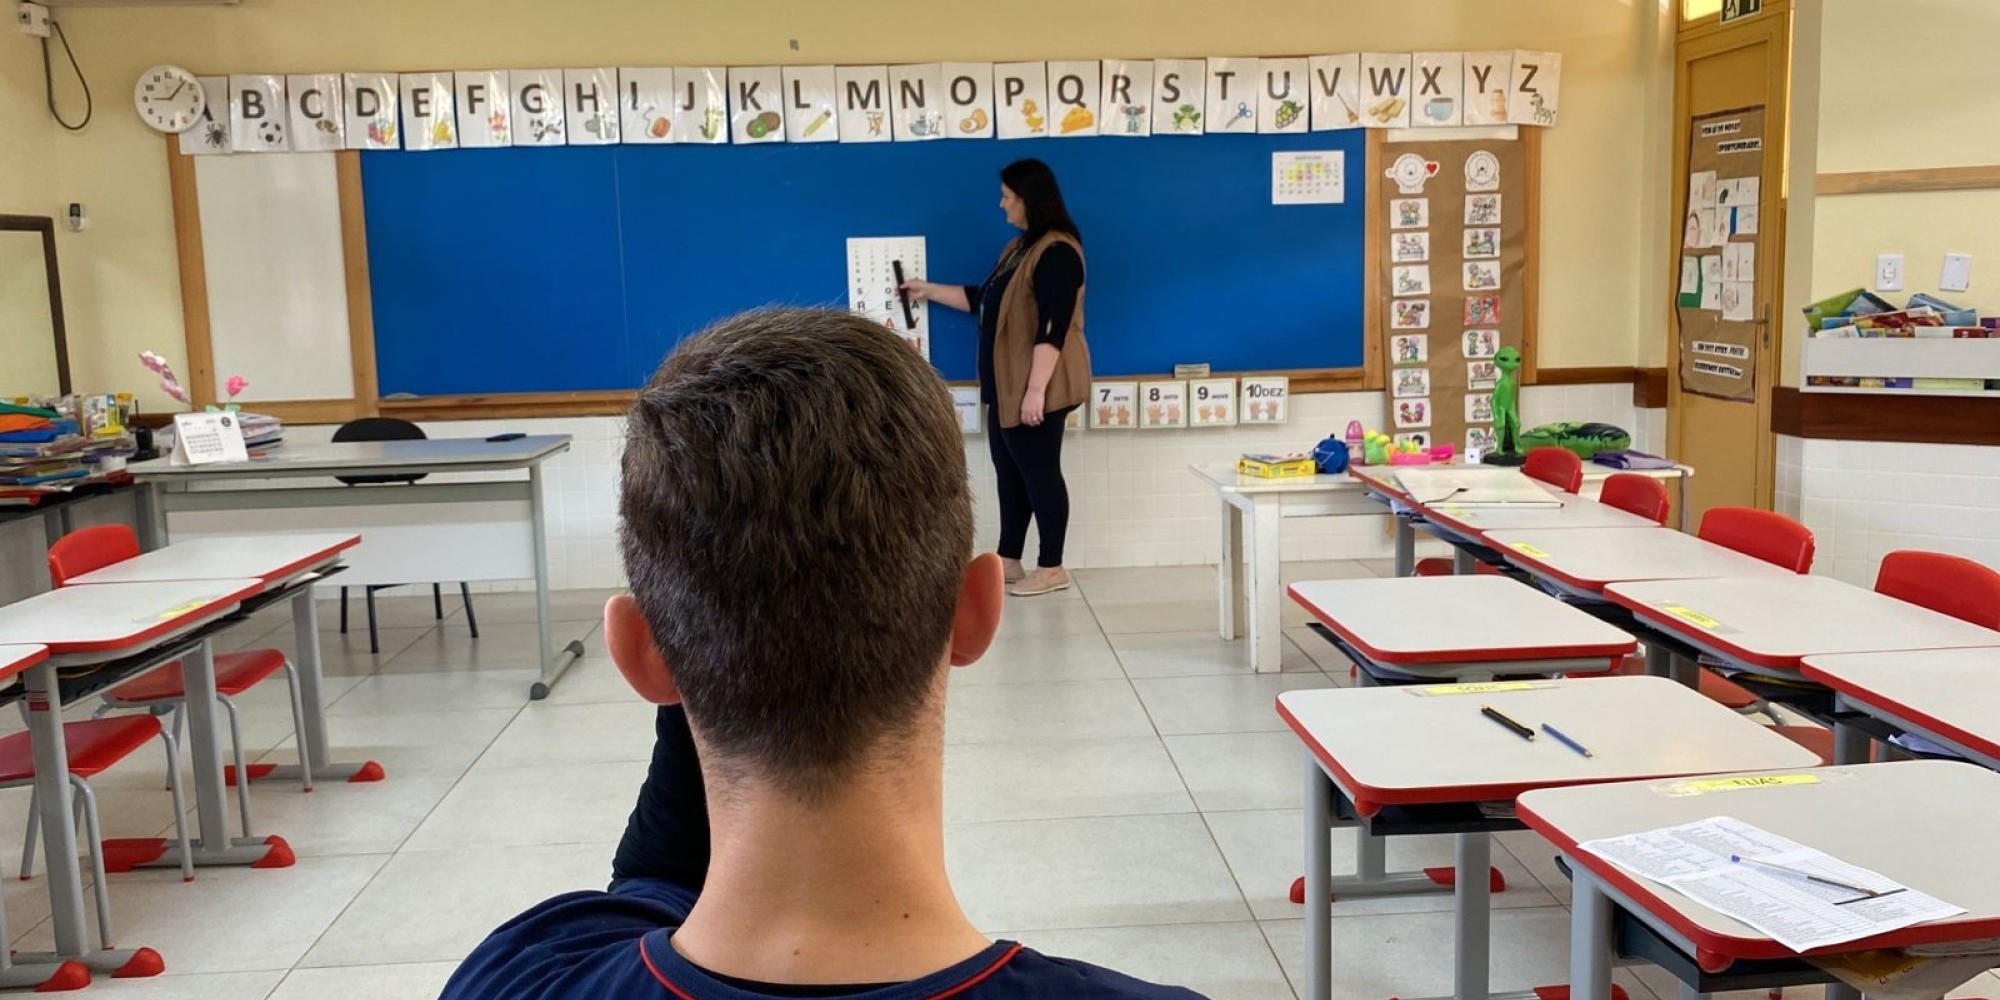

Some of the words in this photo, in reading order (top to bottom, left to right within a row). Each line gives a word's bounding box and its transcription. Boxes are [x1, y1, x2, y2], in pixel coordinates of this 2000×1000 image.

[951, 76, 976, 105] O
[1005, 78, 1024, 106] P
[1058, 75, 1085, 108] Q
[1110, 74, 1131, 104] R
[1162, 73, 1180, 103] S
[1215, 72, 1235, 99] T
[1268, 71, 1291, 99] U
[1317, 67, 1340, 96] V
[1369, 68, 1405, 96] W
[1421, 67, 1441, 94] X
[1472, 66, 1491, 93] Y
[1520, 64, 1539, 93] Z
[242, 89, 265, 119] B
[300, 89, 323, 119] C
[356, 88, 379, 116] D
[412, 88, 430, 117] E
[467, 85, 484, 114] F
[521, 84, 544, 113] G
[576, 83, 598, 112] H
[631, 82, 638, 110] I
[683, 82, 694, 110] J
[740, 82, 761, 110] K
[794, 80, 810, 108] L
[847, 80, 880, 109] M
[901, 79, 924, 108] N
[1100, 388, 1111, 402] 7
[1149, 388, 1160, 402] 8
[1197, 386, 1209, 400] 9
[1246, 384, 1262, 398] 10
[1262, 387, 1283, 397] DEZ
